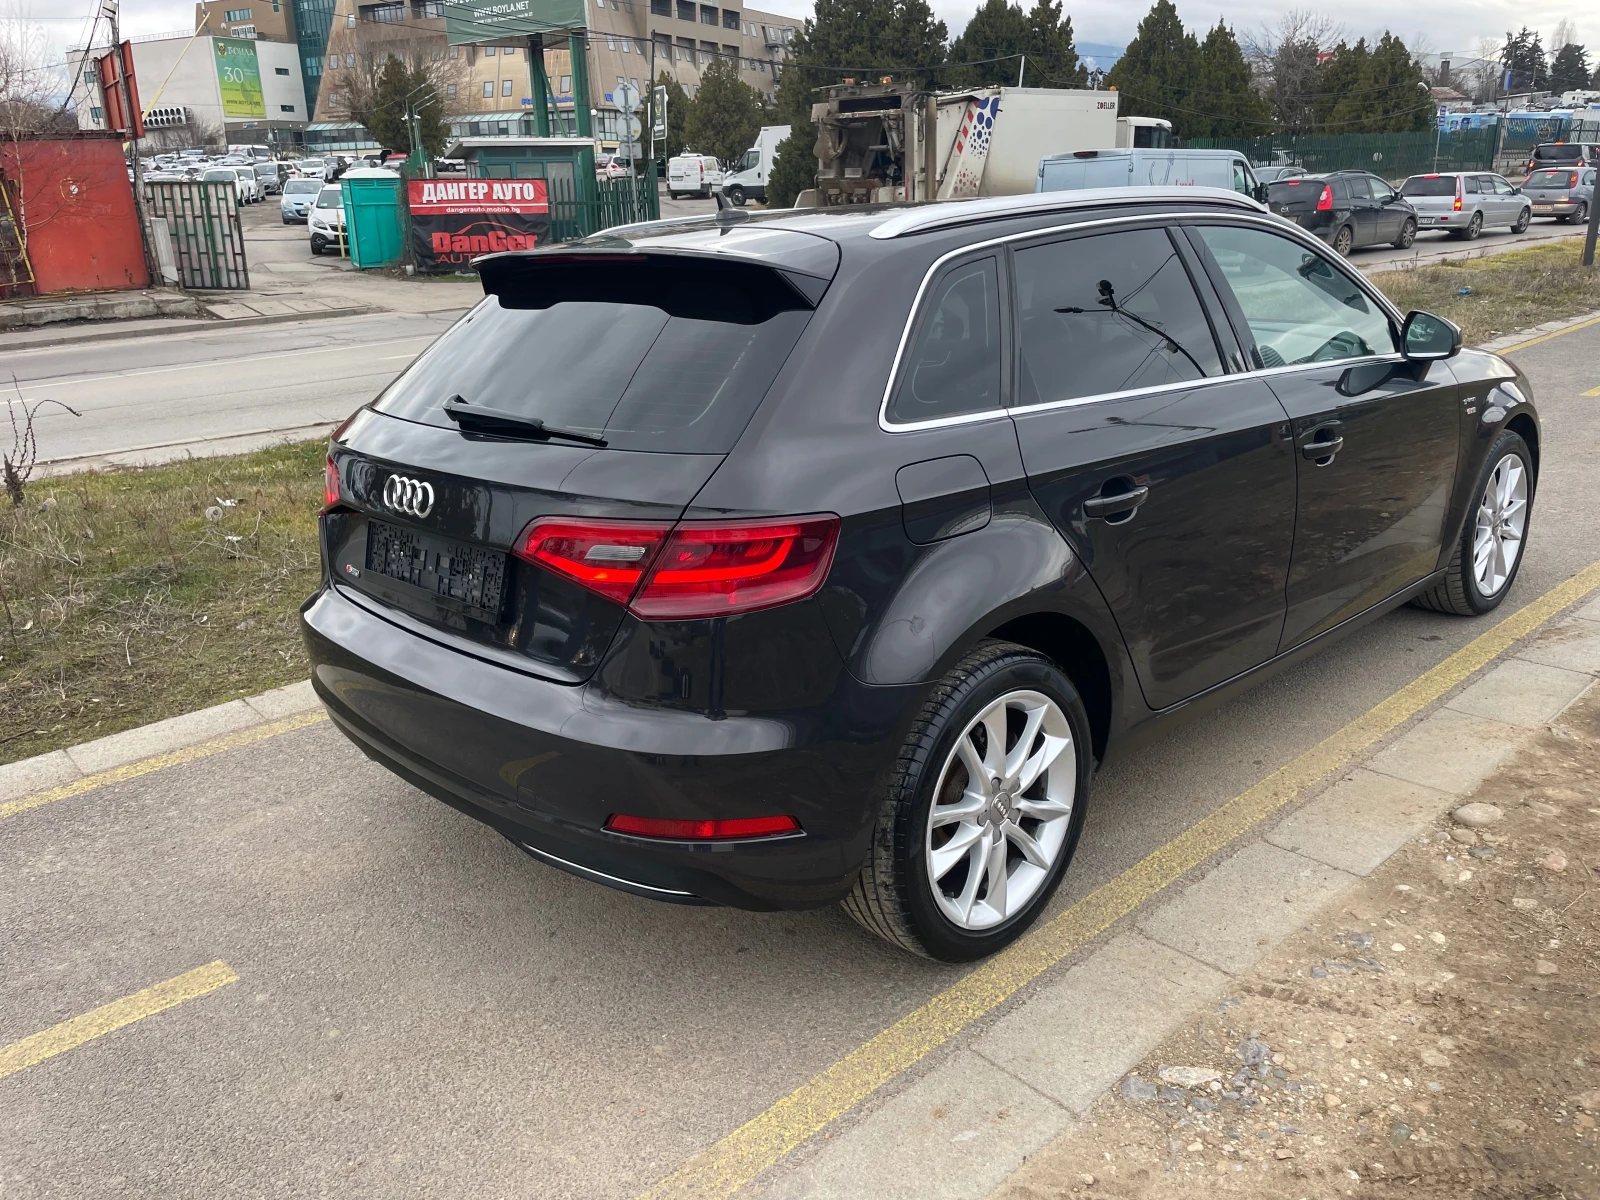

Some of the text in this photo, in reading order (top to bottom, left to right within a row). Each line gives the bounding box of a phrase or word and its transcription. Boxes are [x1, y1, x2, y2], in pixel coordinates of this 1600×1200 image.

[224, 66, 244, 84] 30
[1097, 101, 1116, 110] ZOELLER
[422, 182, 535, 204] ДАНГЕР АУТО
[446, 206, 520, 214] dangerauto.mobile.bg
